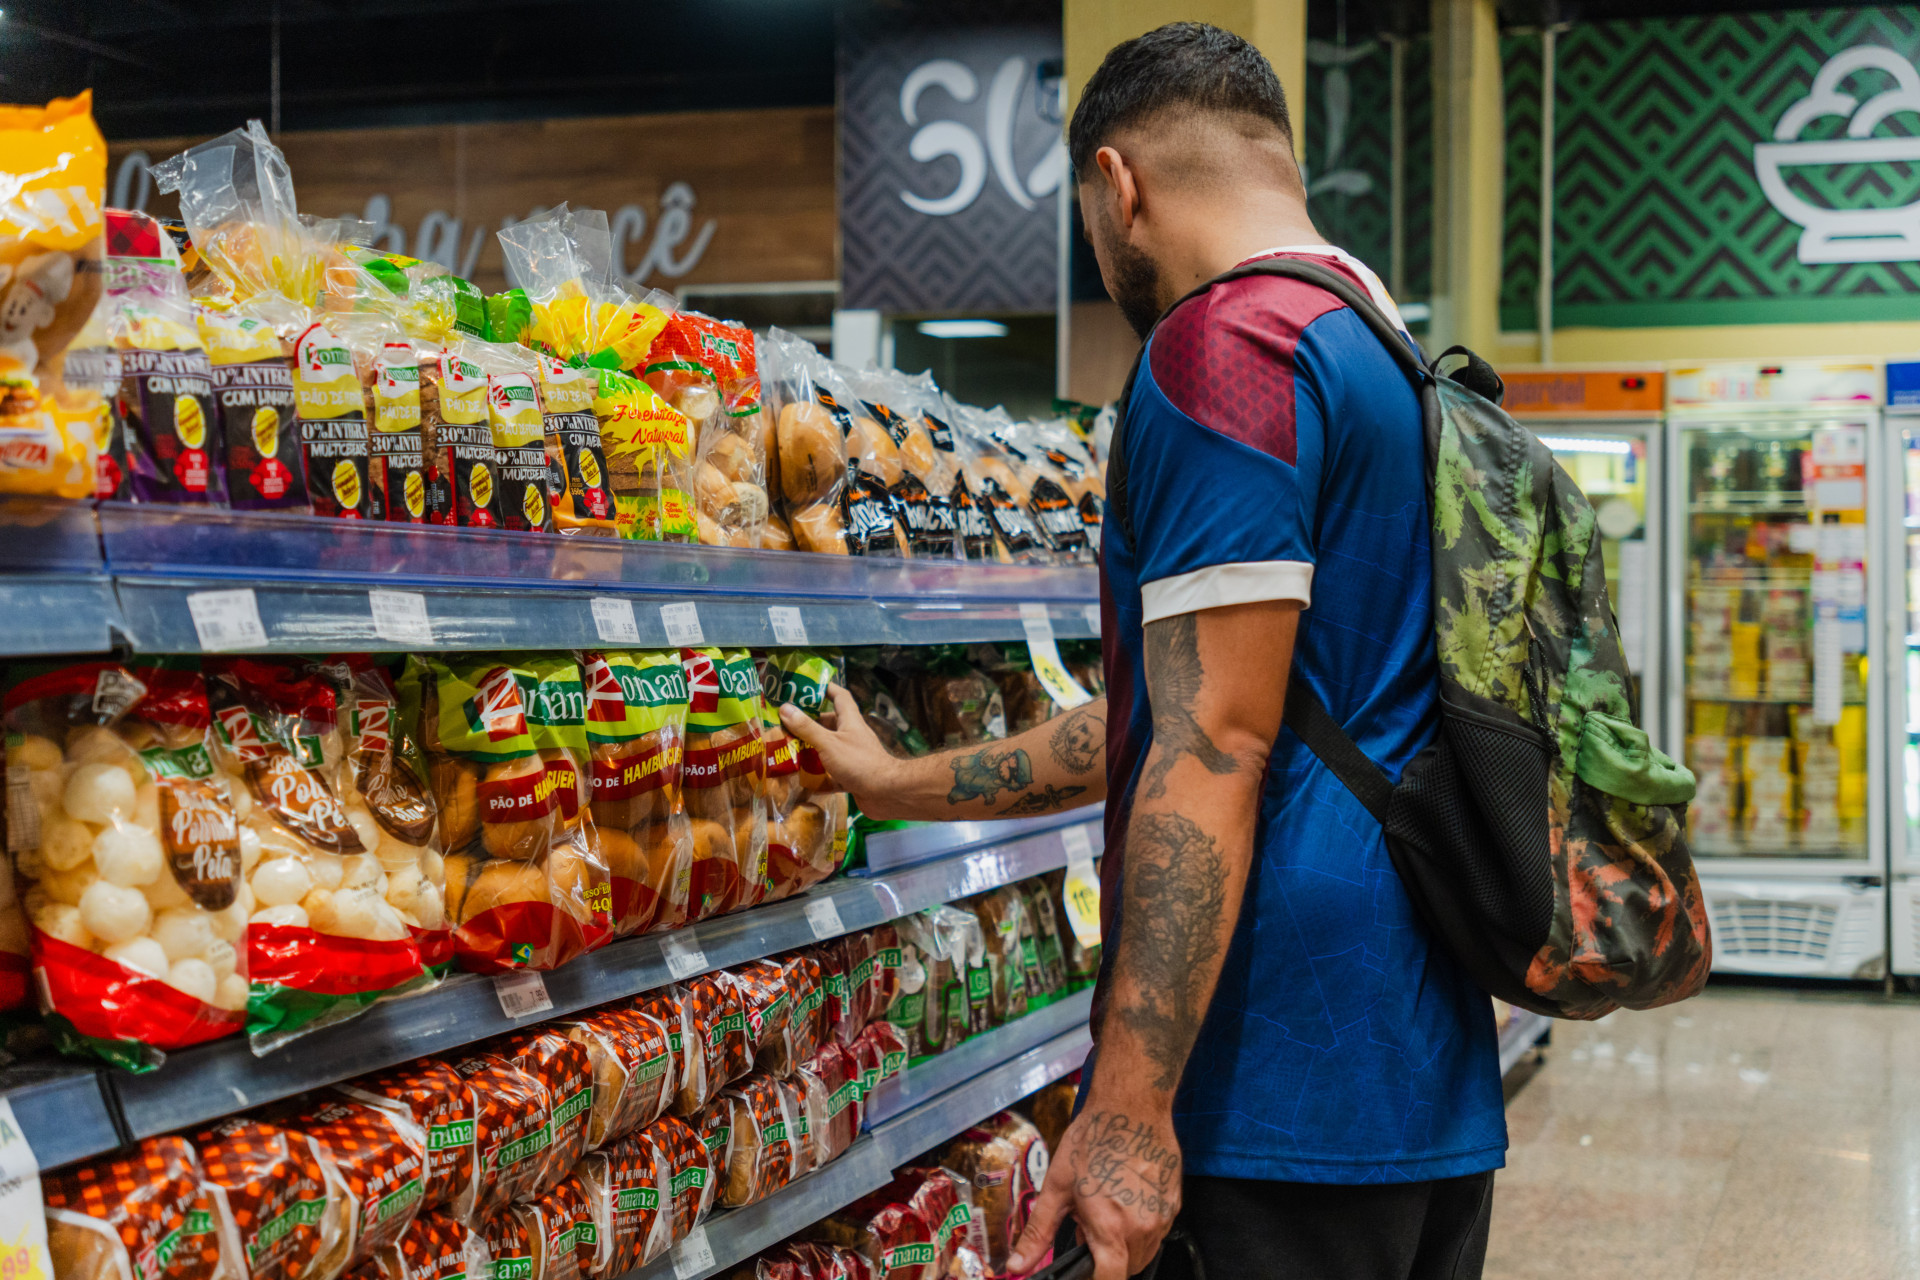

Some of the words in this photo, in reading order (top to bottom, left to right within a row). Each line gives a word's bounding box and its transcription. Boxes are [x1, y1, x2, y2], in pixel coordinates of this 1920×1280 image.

[222, 391, 254, 407] COM
[569, 434, 585, 446] COM
[685, 764, 705, 776] PÃO
[707, 763, 717, 775] DE
[606, 777, 620, 788] DE
[490, 795, 515, 810] PÃO
[518, 794, 533, 808] DE
[554, 1086, 564, 1100] DE
[512, 1119, 522, 1132] DE
